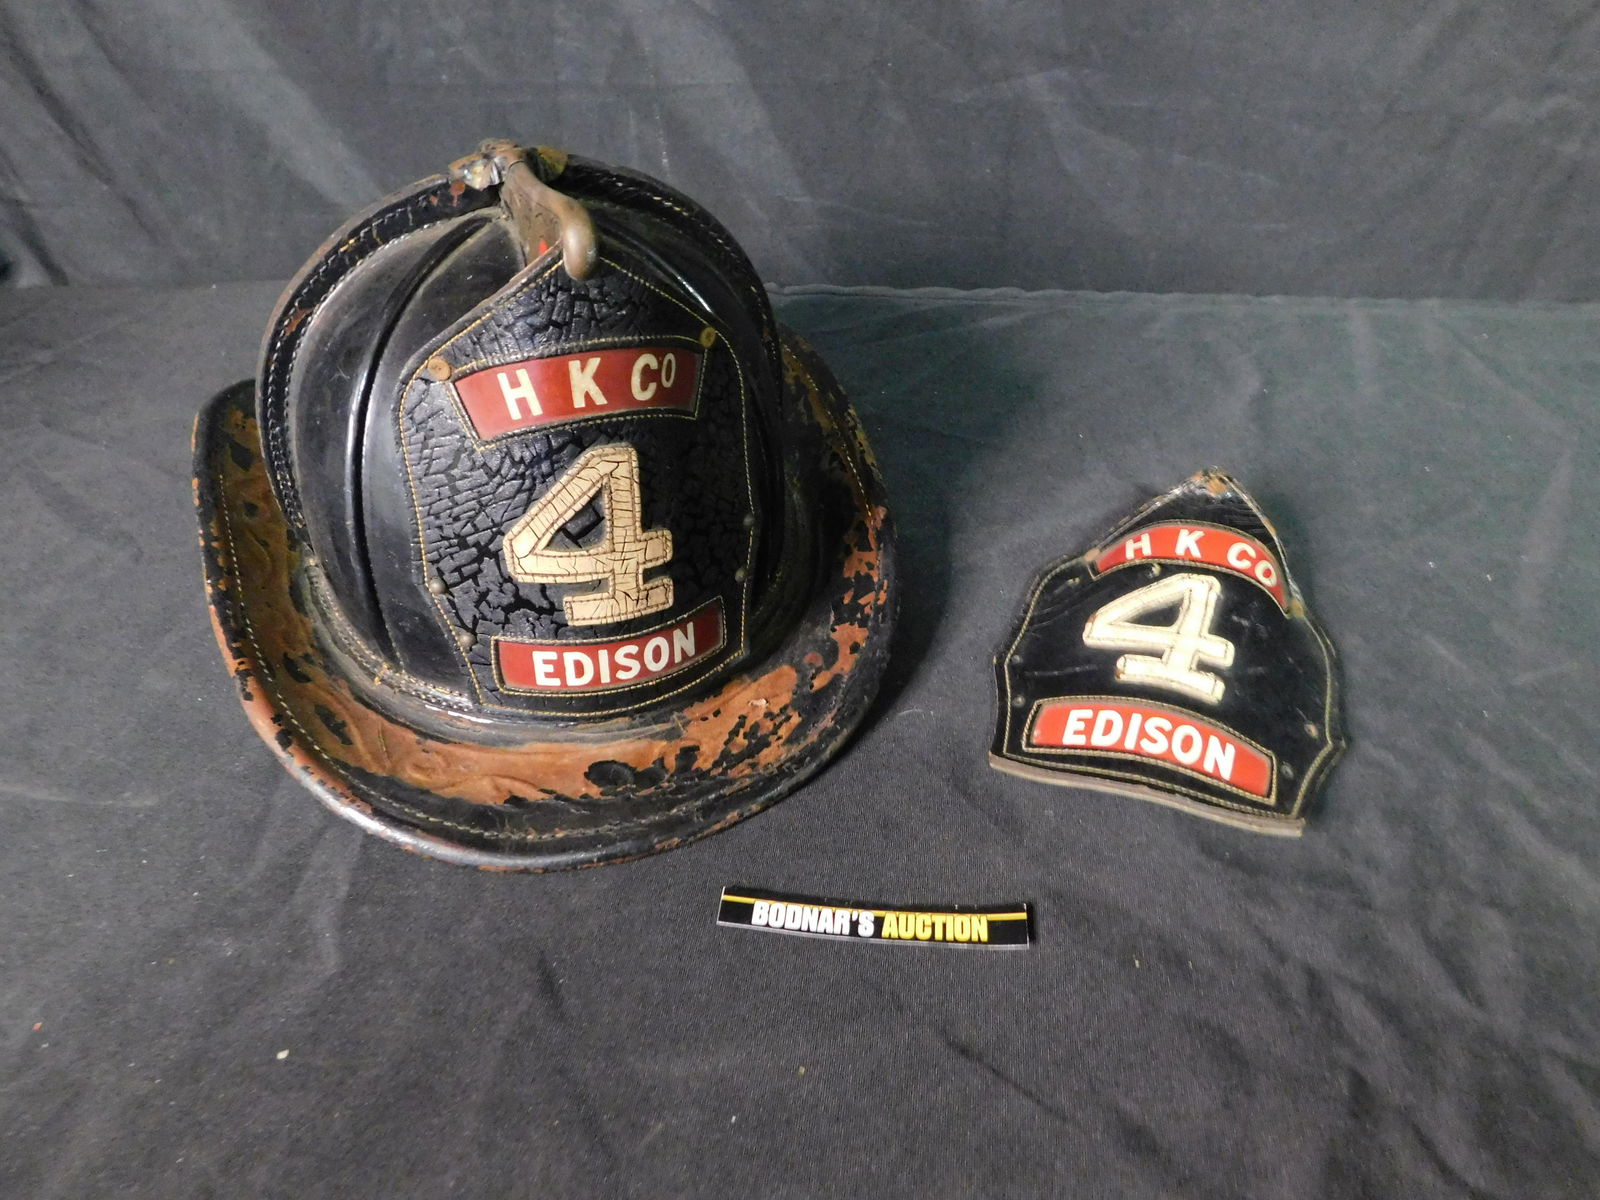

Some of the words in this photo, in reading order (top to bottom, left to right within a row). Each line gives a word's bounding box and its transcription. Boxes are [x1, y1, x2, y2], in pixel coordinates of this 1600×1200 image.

[497, 368, 543, 420] H
[568, 357, 607, 409] K
[502, 442, 674, 626] 4
[1125, 533, 1153, 560] H
[1174, 529, 1206, 558] K
[532, 621, 697, 687] EDISON
[1082, 572, 1235, 706] 4
[1062, 708, 1236, 780] EDISON
[751, 900, 875, 938] BODNAR'S
[881, 912, 989, 943] AUCTION
